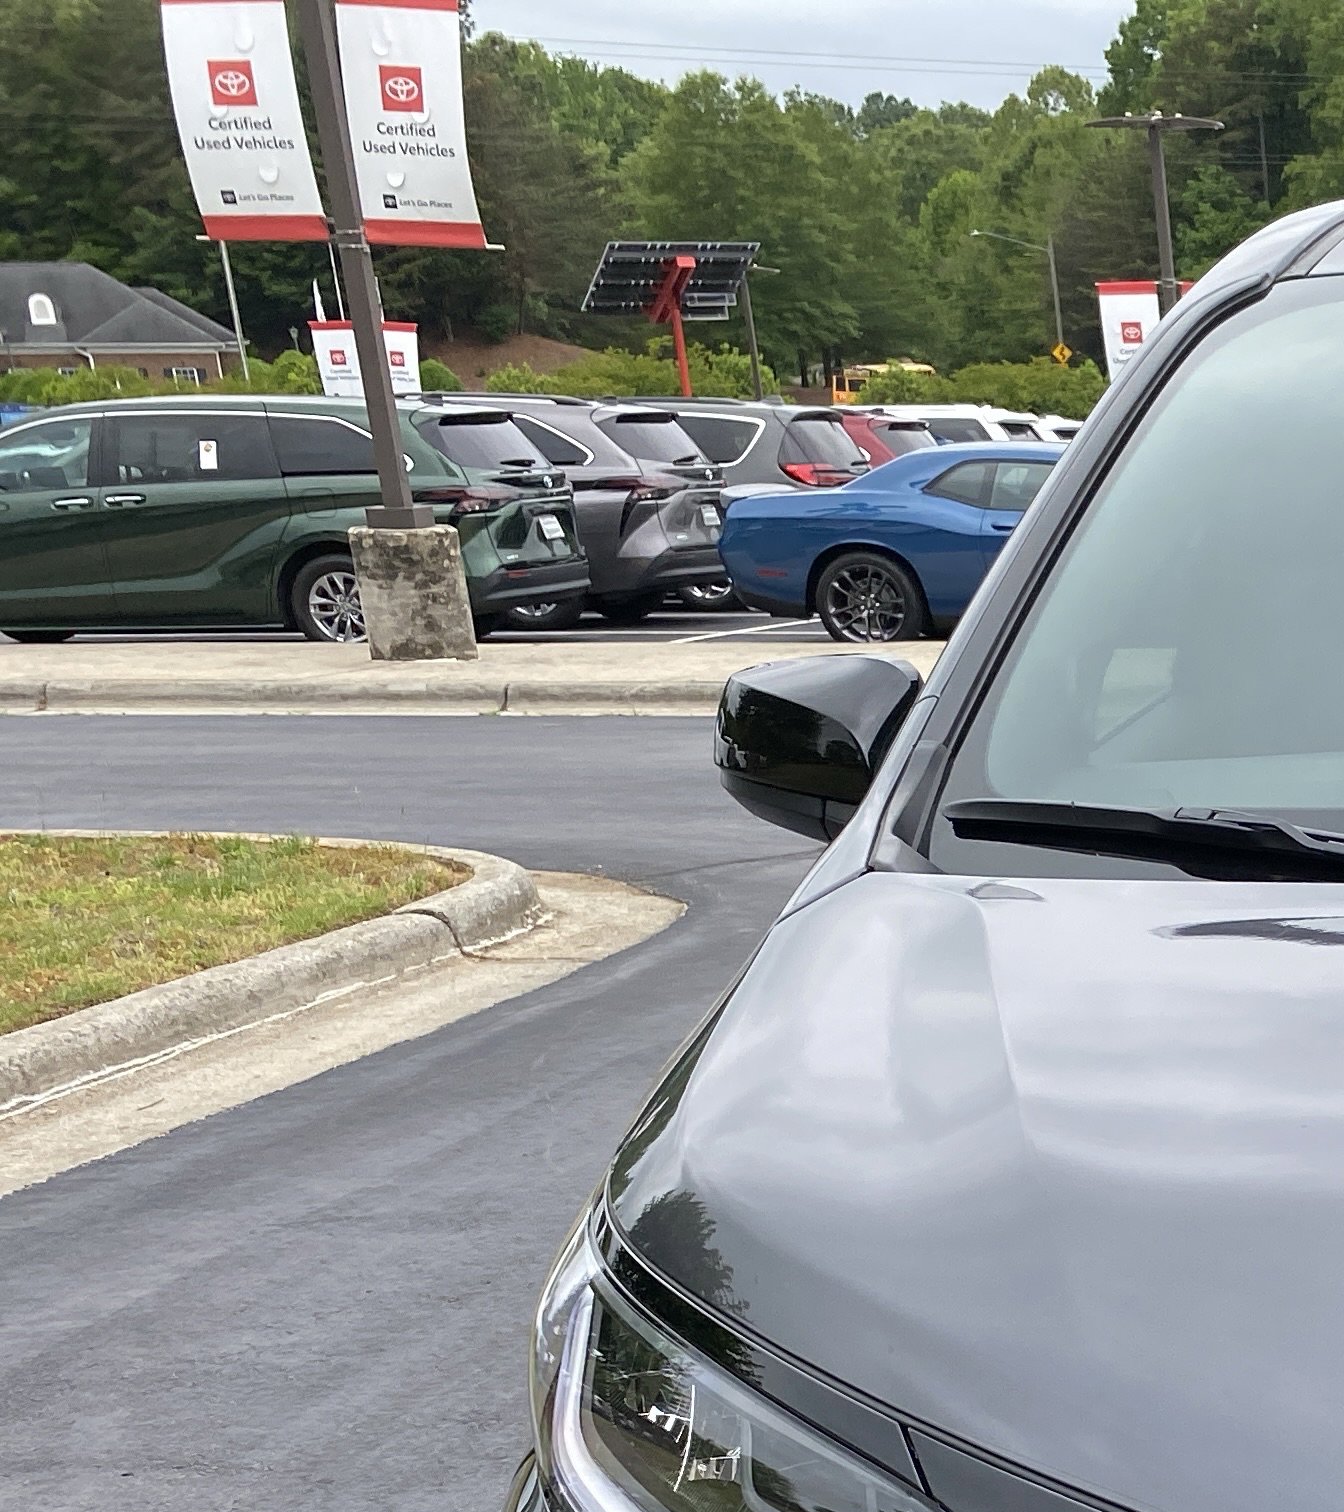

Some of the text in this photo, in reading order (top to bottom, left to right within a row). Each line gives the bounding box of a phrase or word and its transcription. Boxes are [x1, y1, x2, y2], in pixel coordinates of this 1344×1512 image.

[208, 117, 272, 130] Certified
[376, 122, 436, 137] Certified
[194, 136, 295, 150] Used Vehicles
[363, 140, 456, 158] Used Vehicles
